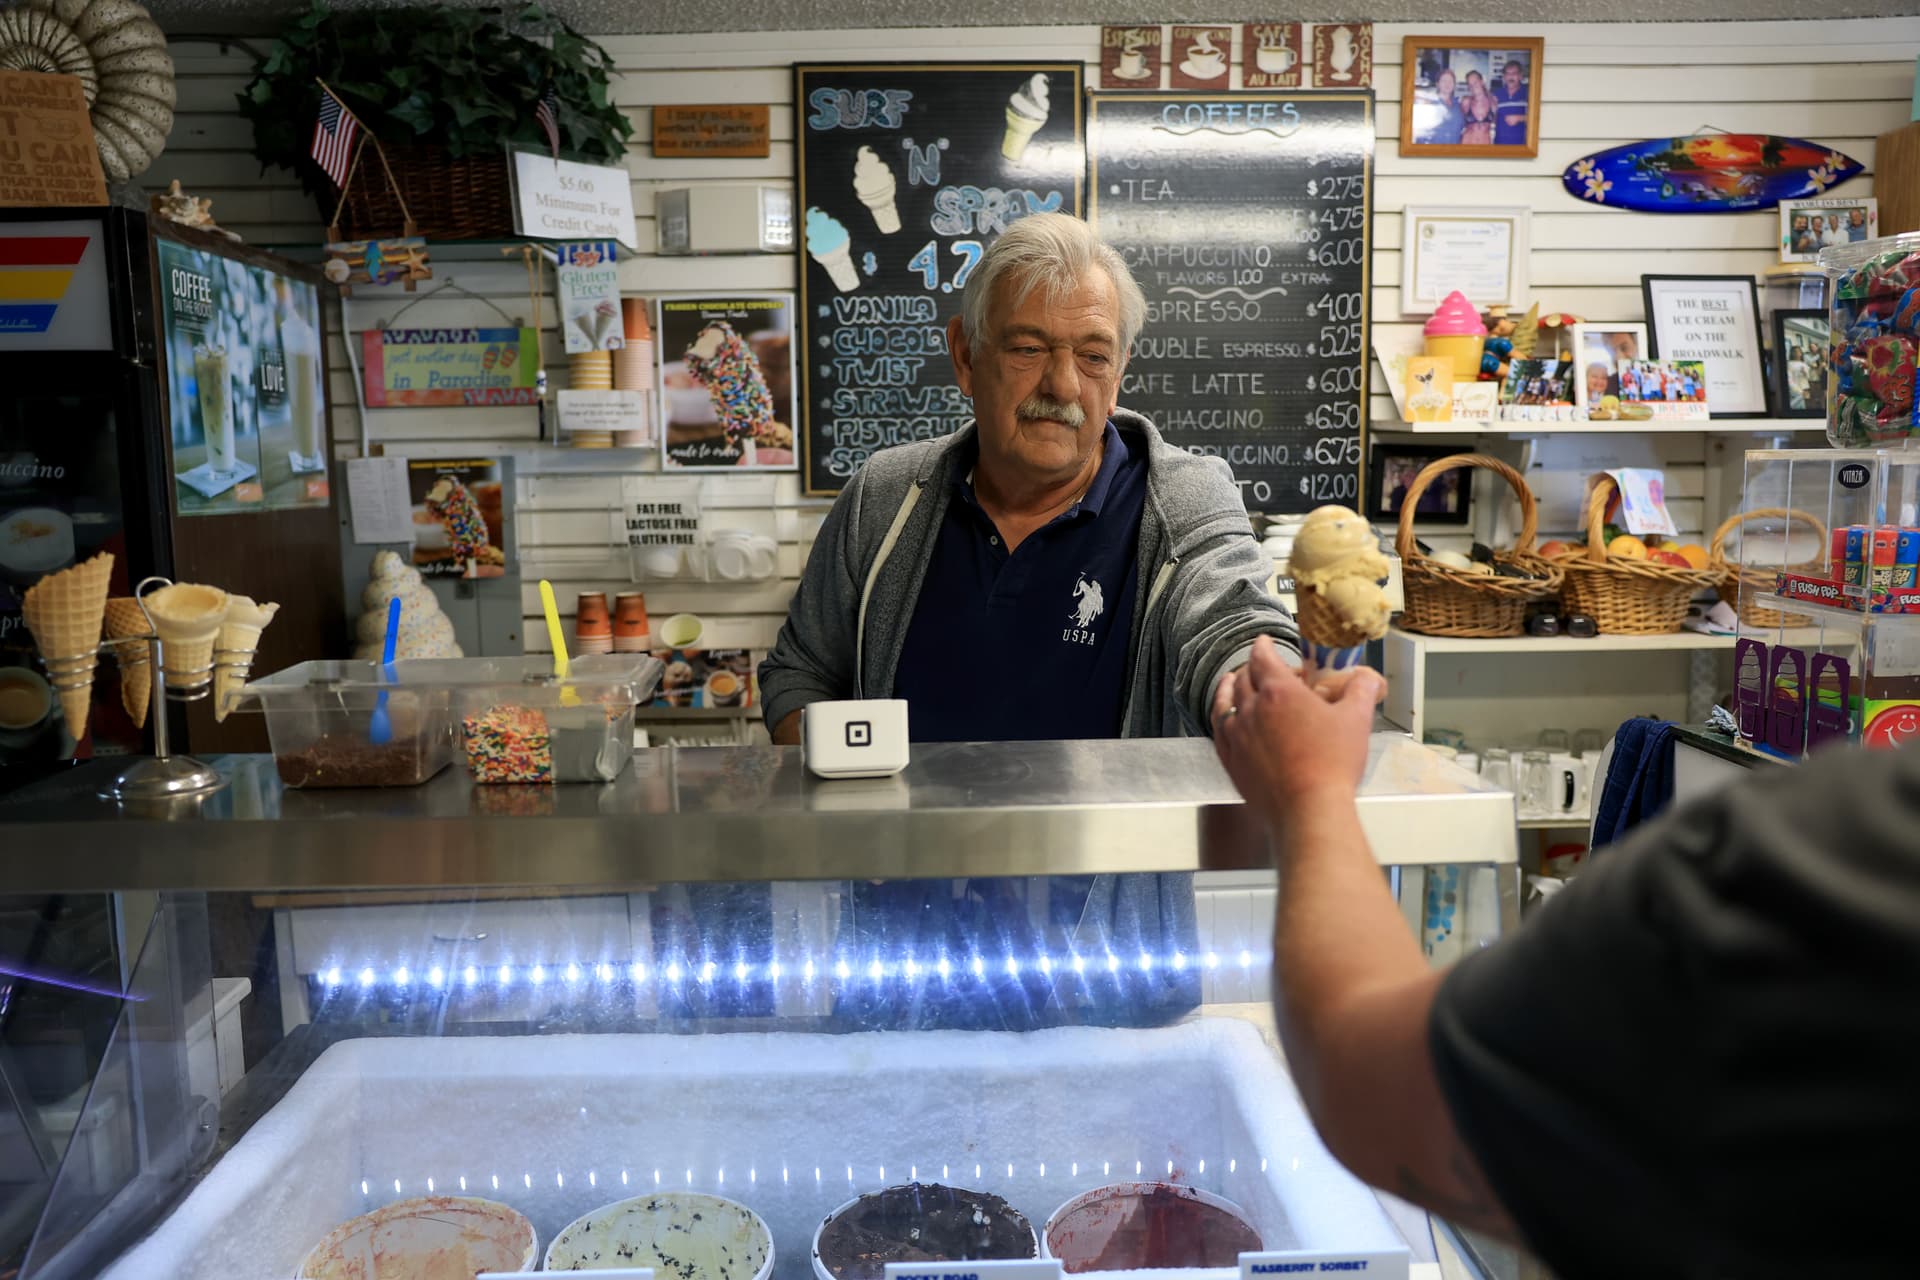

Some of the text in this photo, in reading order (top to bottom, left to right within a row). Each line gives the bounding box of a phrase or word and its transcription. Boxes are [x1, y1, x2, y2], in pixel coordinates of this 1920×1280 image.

[1248, 73, 1298, 86] AU LAIT
[808, 87, 913, 131] SURF
[0, 110, 19, 136] T
[30, 142, 92, 164] CAN
[559, 176, 594, 193] $5.00
[1122, 179, 1174, 202] TEA
[535, 192, 621, 217] Minimum For
[542, 214, 619, 235] Credit Cards
[862, 240, 984, 293] $ 4.7
[1121, 245, 1272, 269] CAPPUCCINO
[171, 268, 212, 303] COFFEE
[1156, 269, 1332, 286] FLAVORS 1.00 EXTRA
[1146, 300, 1260, 323] SPRESSO
[1676, 299, 1728, 309] THE BEST
[1673, 316, 1736, 325] ICE CREAM
[833, 327, 949, 356] CHOCOLA
[1685, 332, 1727, 342] ON THE
[1223, 343, 1301, 358] ESPRESSO
[1672, 349, 1744, 359] BROADWALK
[261, 364, 285, 392] LOVE
[393, 368, 513, 389] in Paradise
[833, 356, 925, 385] TWIST
[1120, 373, 1176, 395] CAFE
[1192, 373, 1265, 395] LATTE
[832, 386, 974, 417] STRAWBE
[0, 457, 65, 479] uccino
[1234, 473, 1357, 502] TO $12.00
[637, 503, 682, 515] FAT FREE
[626, 518, 698, 530] LACTOSE FREE
[629, 534, 695, 546] GLUTEN FREE
[1798, 582, 1839, 599] PUSH POP
[1900, 594, 1920, 605] PUS
[1062, 629, 1095, 645] USPA
[1251, 1260, 1368, 1274] RASBERRY SORBET
